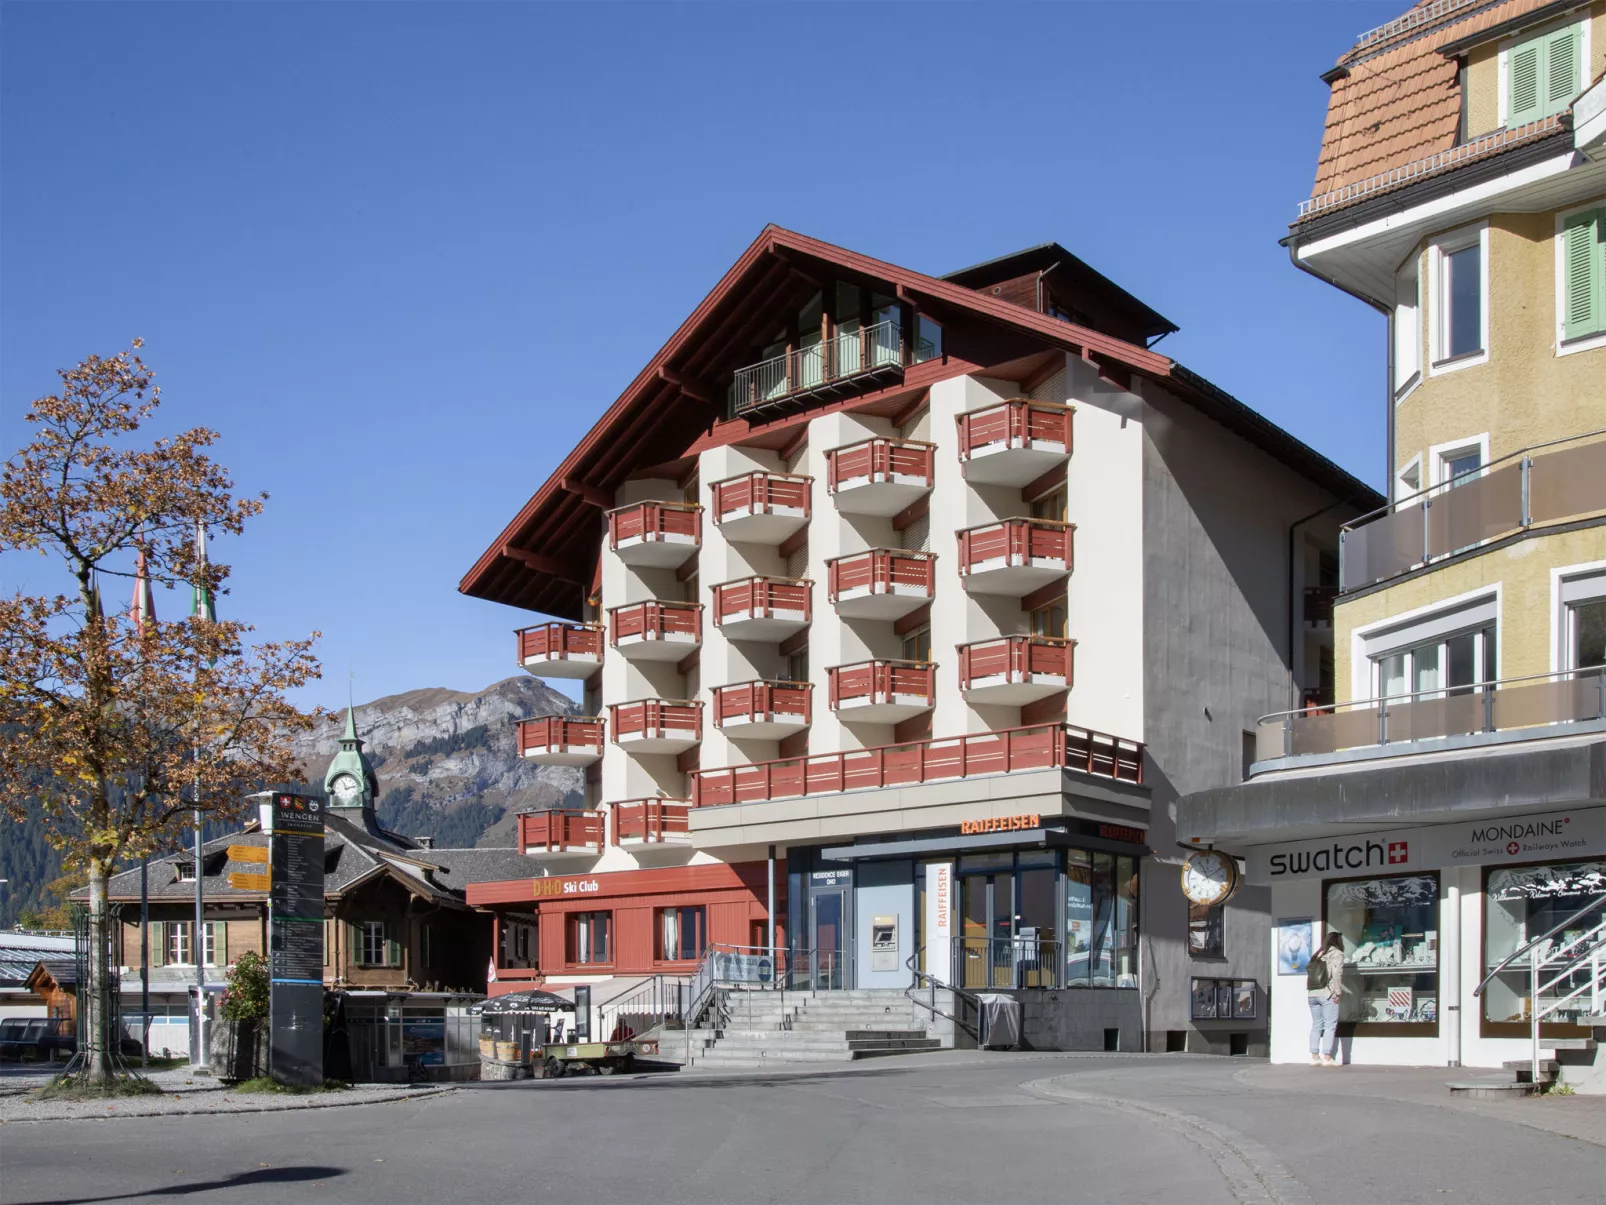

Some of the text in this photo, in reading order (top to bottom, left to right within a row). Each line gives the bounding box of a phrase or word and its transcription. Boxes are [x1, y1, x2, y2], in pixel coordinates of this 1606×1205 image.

[280, 811, 320, 822] WENGEN
[961, 814, 1040, 834] RAIFFEISEN
[1471, 820, 1563, 843] MONDAINE
[1270, 840, 1384, 875] swatch
[1452, 837, 1587, 858] Official Swiss Railways Watch
[563, 881, 577, 894] Ski
[578, 879, 599, 893] Club
[938, 868, 948, 927] RAIFFEISEN
